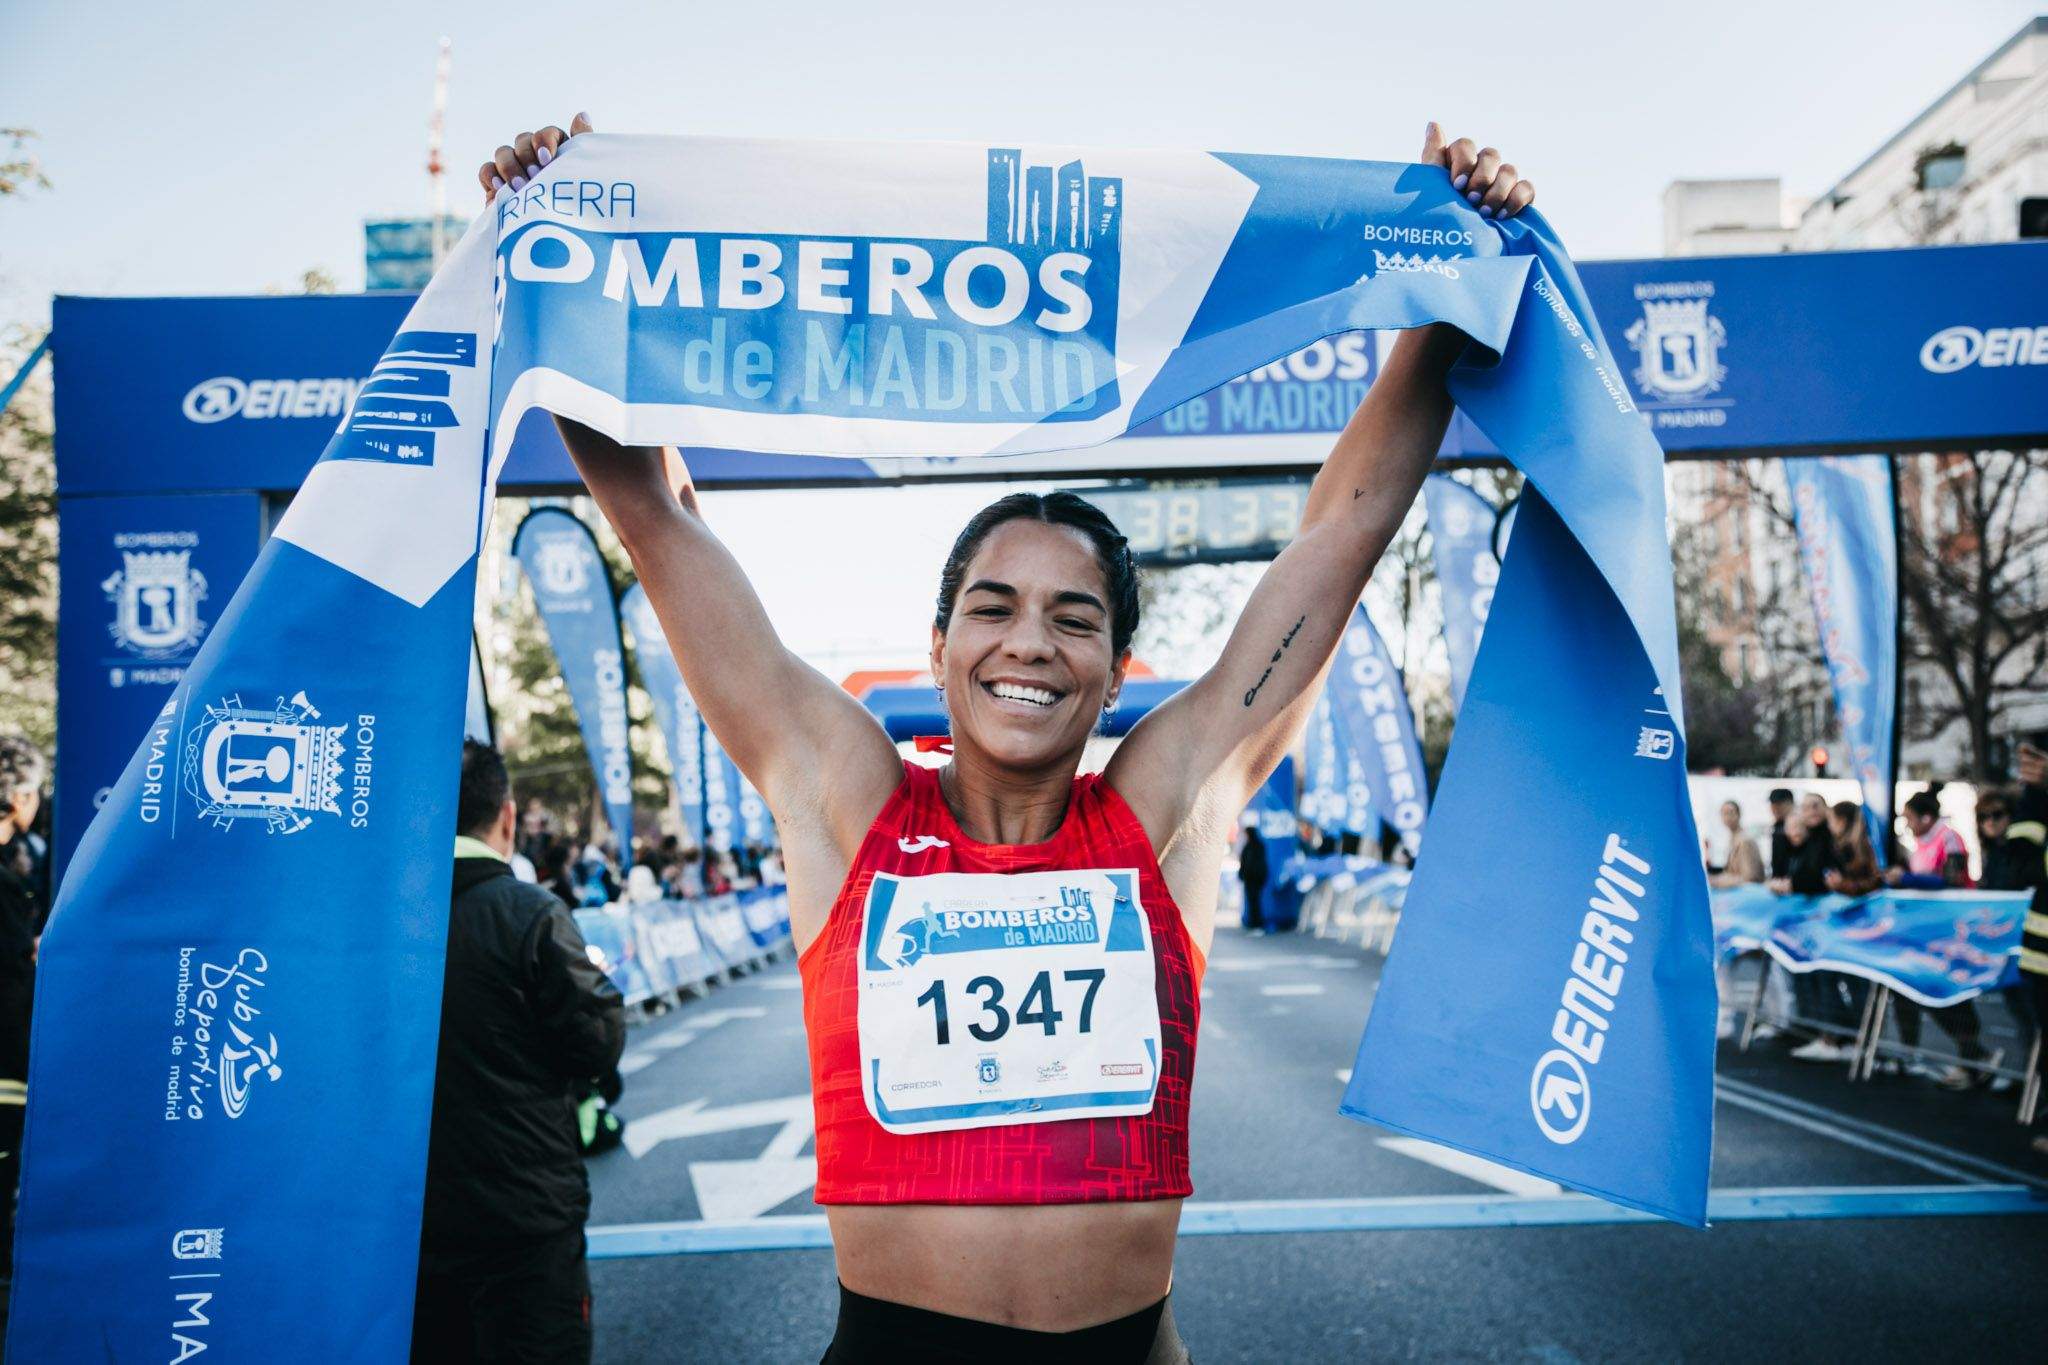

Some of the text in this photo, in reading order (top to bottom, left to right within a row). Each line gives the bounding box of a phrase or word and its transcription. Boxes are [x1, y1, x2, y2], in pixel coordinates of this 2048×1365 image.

[497, 181, 636, 229] RRERA
[1363, 224, 1474, 247] BOMBEROS
[494, 224, 1093, 334] OMBEROS
[682, 317, 1100, 414] de MADRID
[1532, 277, 1632, 414] bomberos de madrid
[139, 727, 171, 824] MADRID
[350, 713, 376, 829] BOMBEROS
[943, 905, 1092, 931] BOMBEROS
[1004, 922, 1096, 947] de MADRID
[1551, 833, 1651, 1065] ENERVIT
[233, 947, 269, 1022] Club
[916, 967, 1106, 1046] 1347
[165, 946, 197, 1122] bomberos de madrid
[187, 962, 239, 1121] Deportivo
